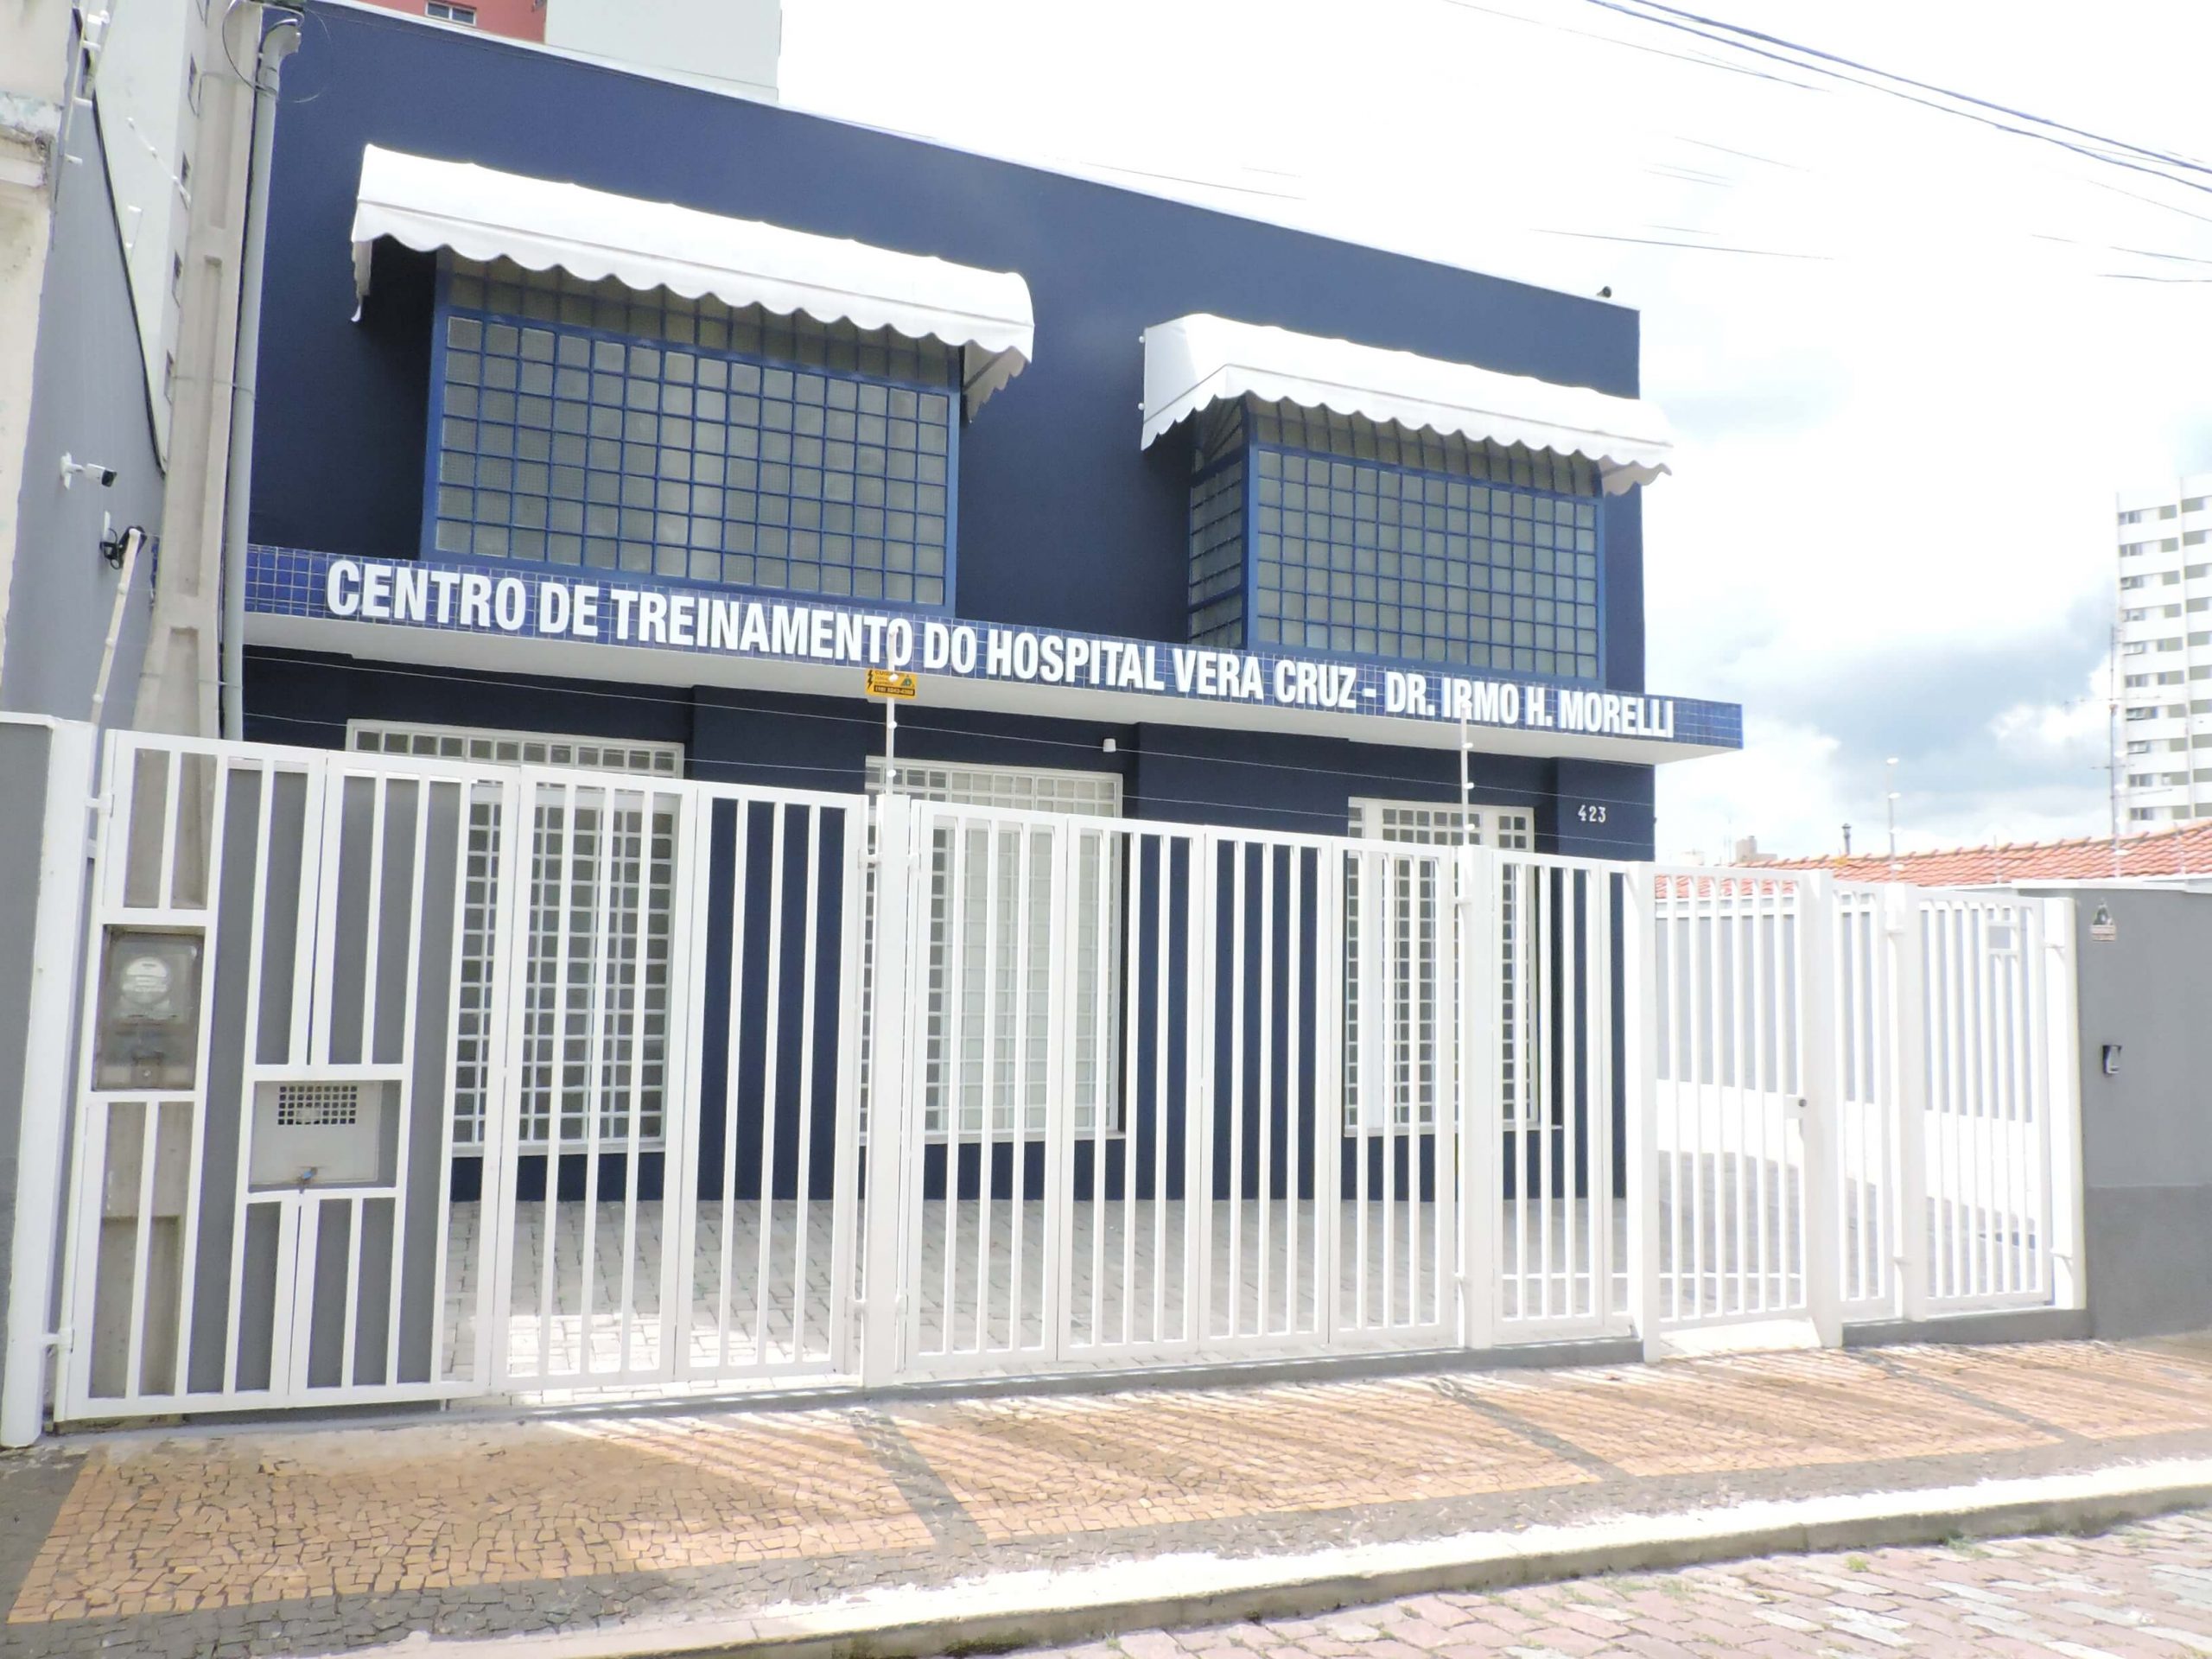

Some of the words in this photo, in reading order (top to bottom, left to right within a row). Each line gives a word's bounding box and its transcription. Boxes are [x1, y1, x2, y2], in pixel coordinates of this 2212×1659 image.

[327, 561, 526, 632] CENTRO
[540, 584, 598, 636] DE
[611, 589, 912, 666] TREINAMENTO
[924, 623, 976, 674] DO
[986, 629, 1165, 691] HOSPITAL
[1173, 648, 1264, 700] VERA
[1274, 659, 1356, 708] CRUZ
[1386, 671, 1435, 716] DR.
[1441, 677, 1519, 724] IRMO
[1525, 685, 1553, 726] H.
[1559, 690, 1674, 738] MORELLI
[1578, 804, 1605, 823] 423
